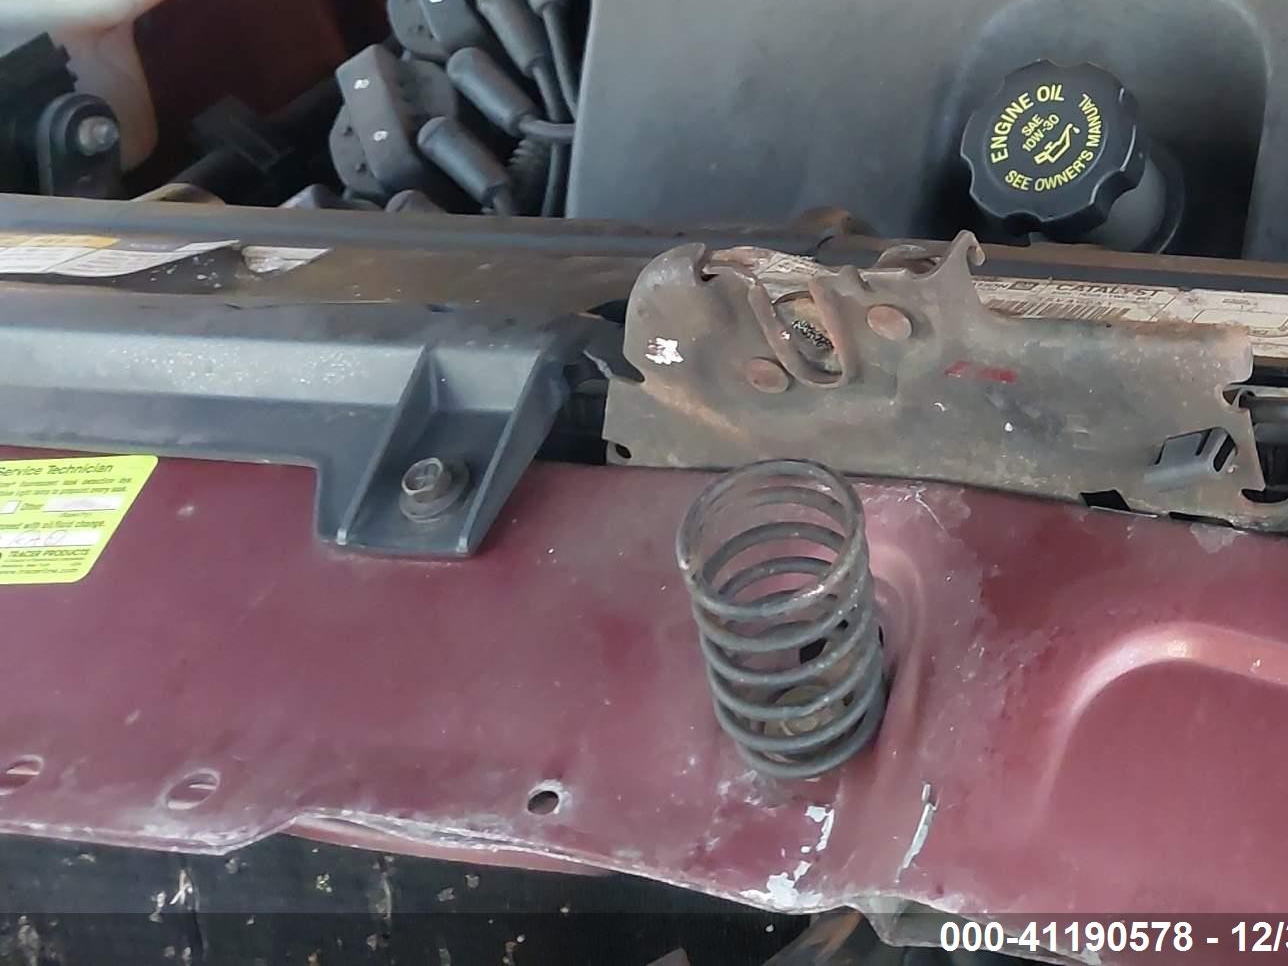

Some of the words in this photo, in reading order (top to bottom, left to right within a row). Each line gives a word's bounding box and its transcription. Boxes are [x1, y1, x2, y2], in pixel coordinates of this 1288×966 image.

[990, 91, 1035, 164] ENGINE
[1036, 84, 1065, 102] OIL
[1021, 113, 1045, 137] SAE
[1022, 113, 1060, 152] 10W-30
[1004, 169, 1031, 191] SEE
[1034, 150, 1094, 192] OWNER'S
[1077, 93, 1102, 148] MANUAL
[1055, 283, 1164, 297] CATALYST
[47, 463, 114, 475] Technician
